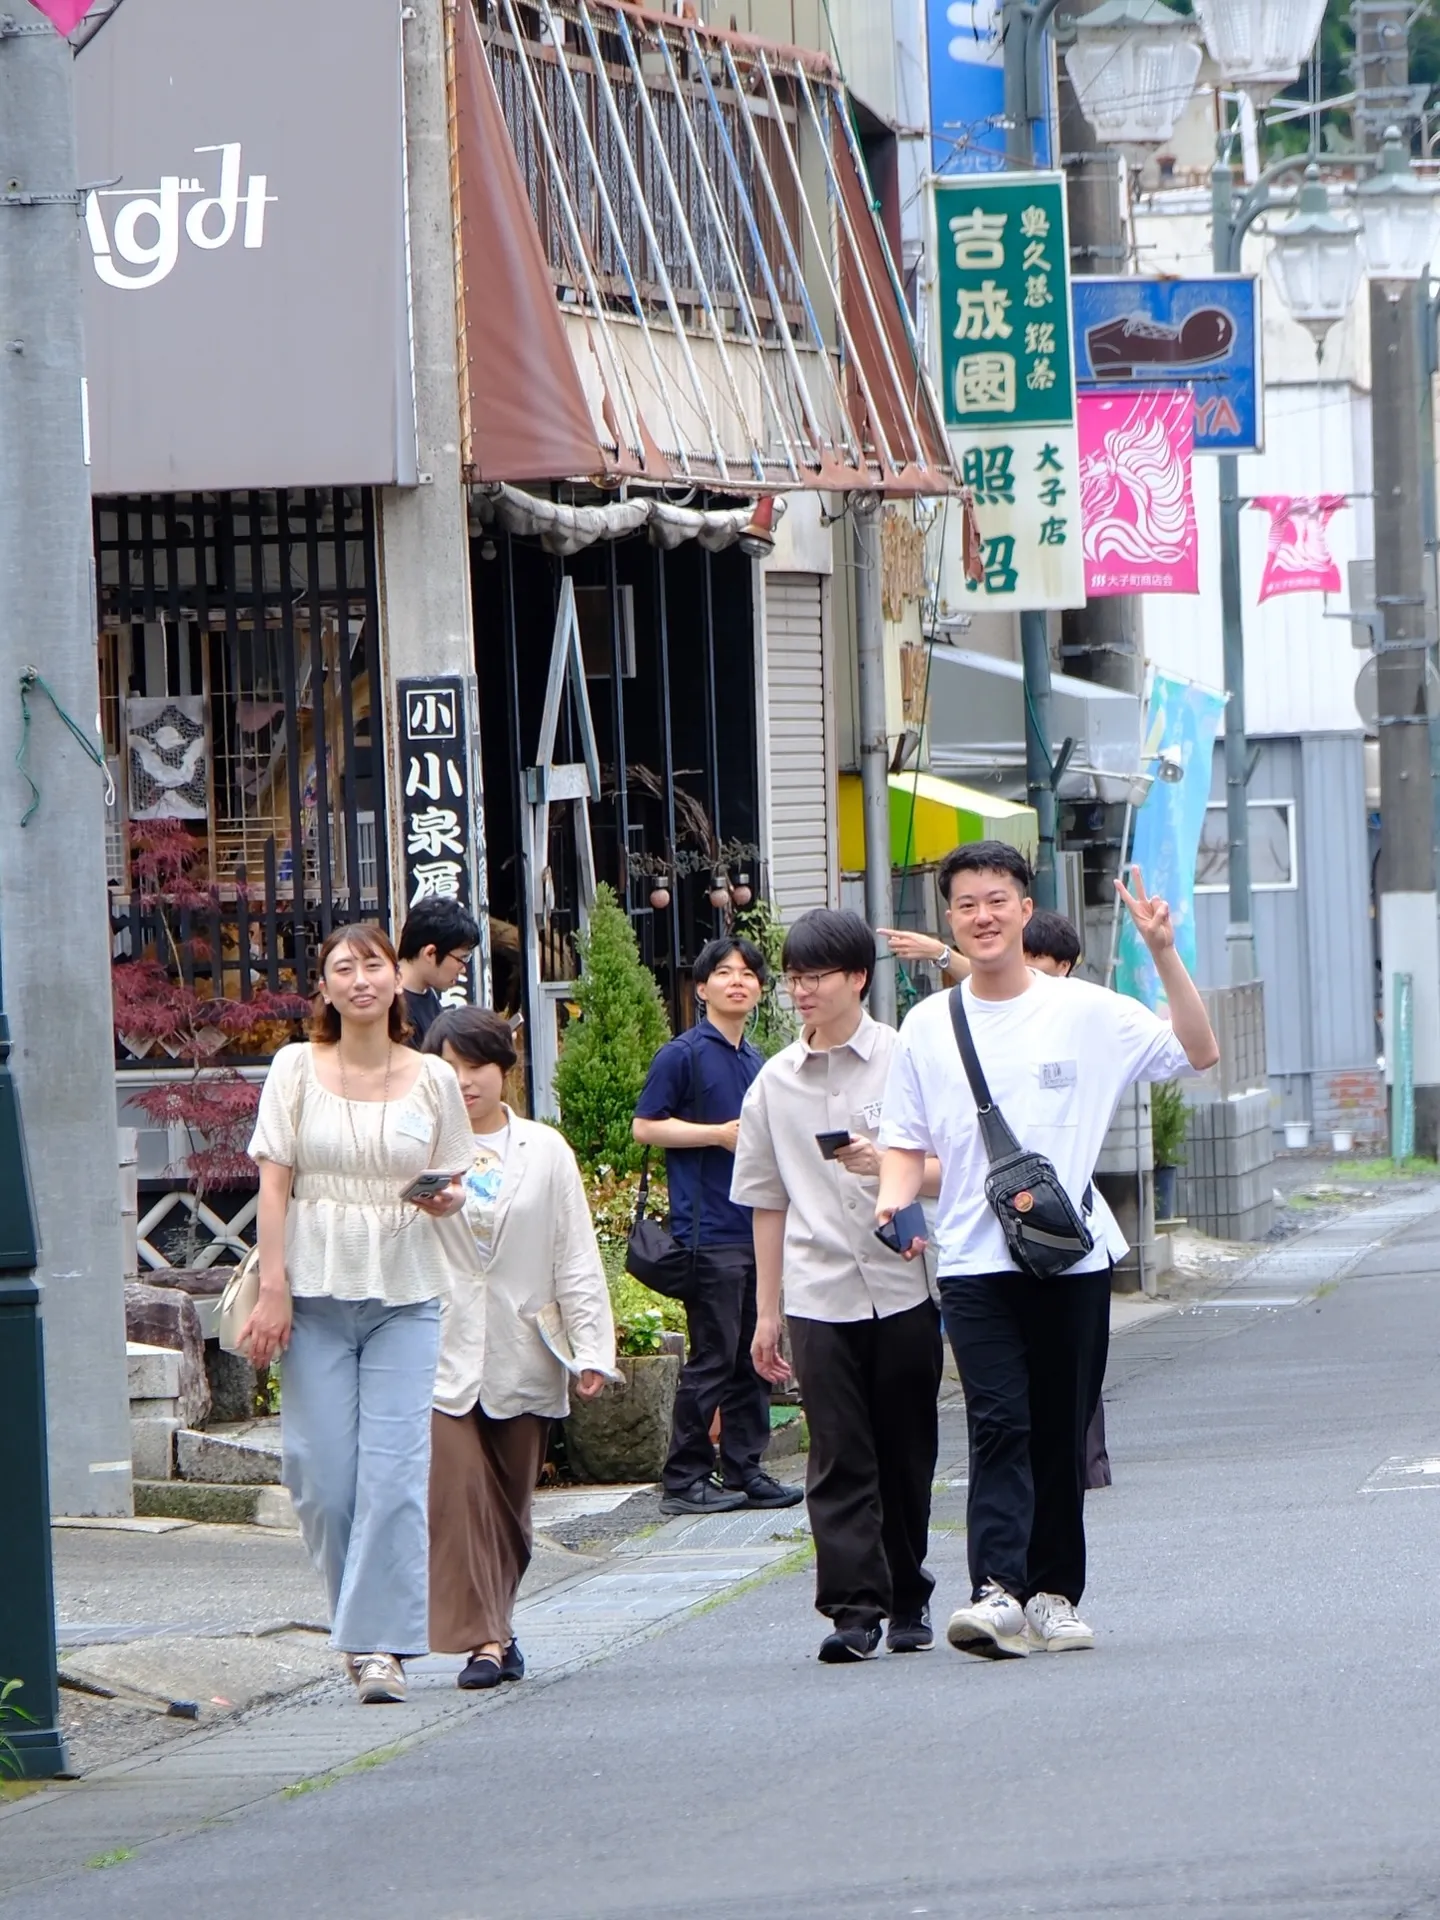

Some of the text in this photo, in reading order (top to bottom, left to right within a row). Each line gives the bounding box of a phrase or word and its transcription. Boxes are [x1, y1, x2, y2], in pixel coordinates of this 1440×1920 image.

[1194, 396, 1241, 437] YA
[1034, 441, 1067, 547] 大子店
